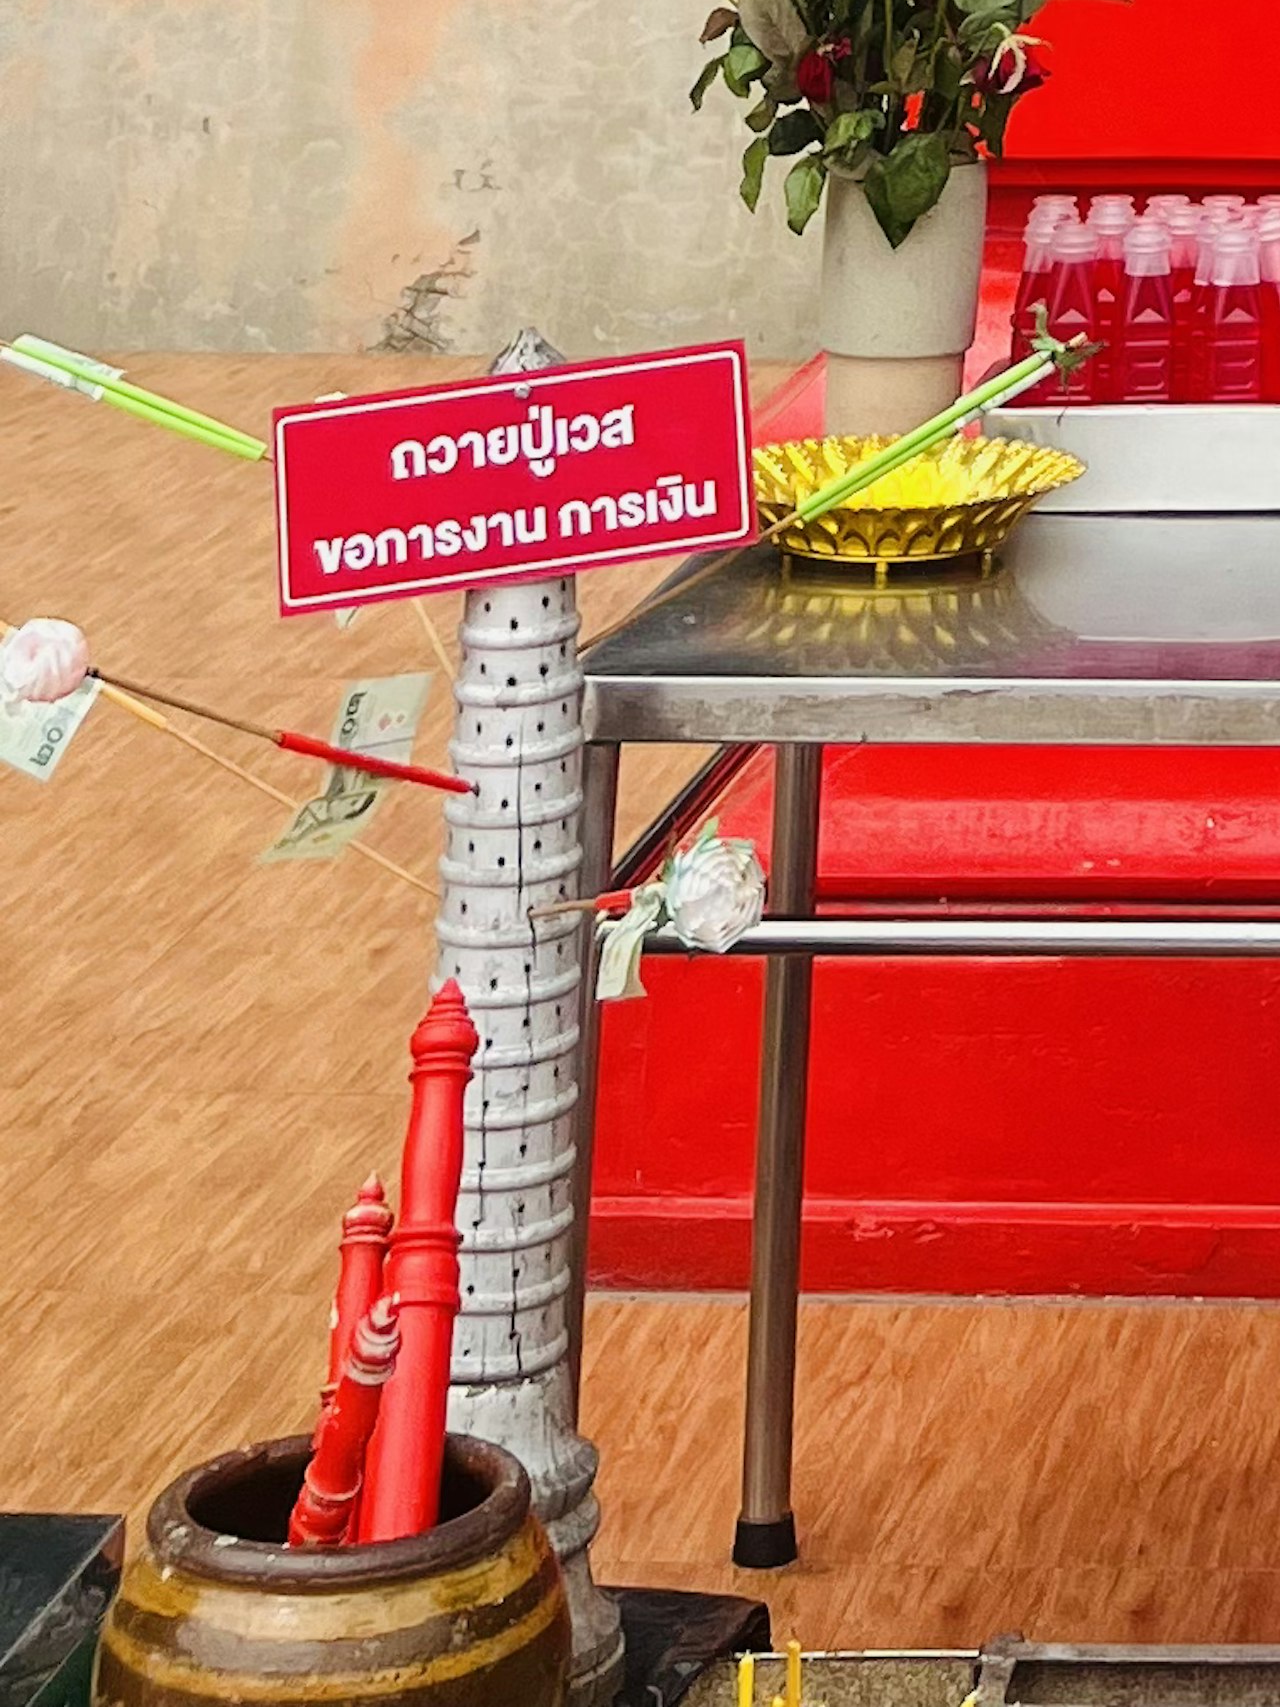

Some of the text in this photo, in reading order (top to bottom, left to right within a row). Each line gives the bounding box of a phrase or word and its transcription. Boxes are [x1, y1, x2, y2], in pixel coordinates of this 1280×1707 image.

[390, 403, 635, 480] ถวายปู่เวส
[313, 473, 717, 575] ขอการงาน การเงิน
